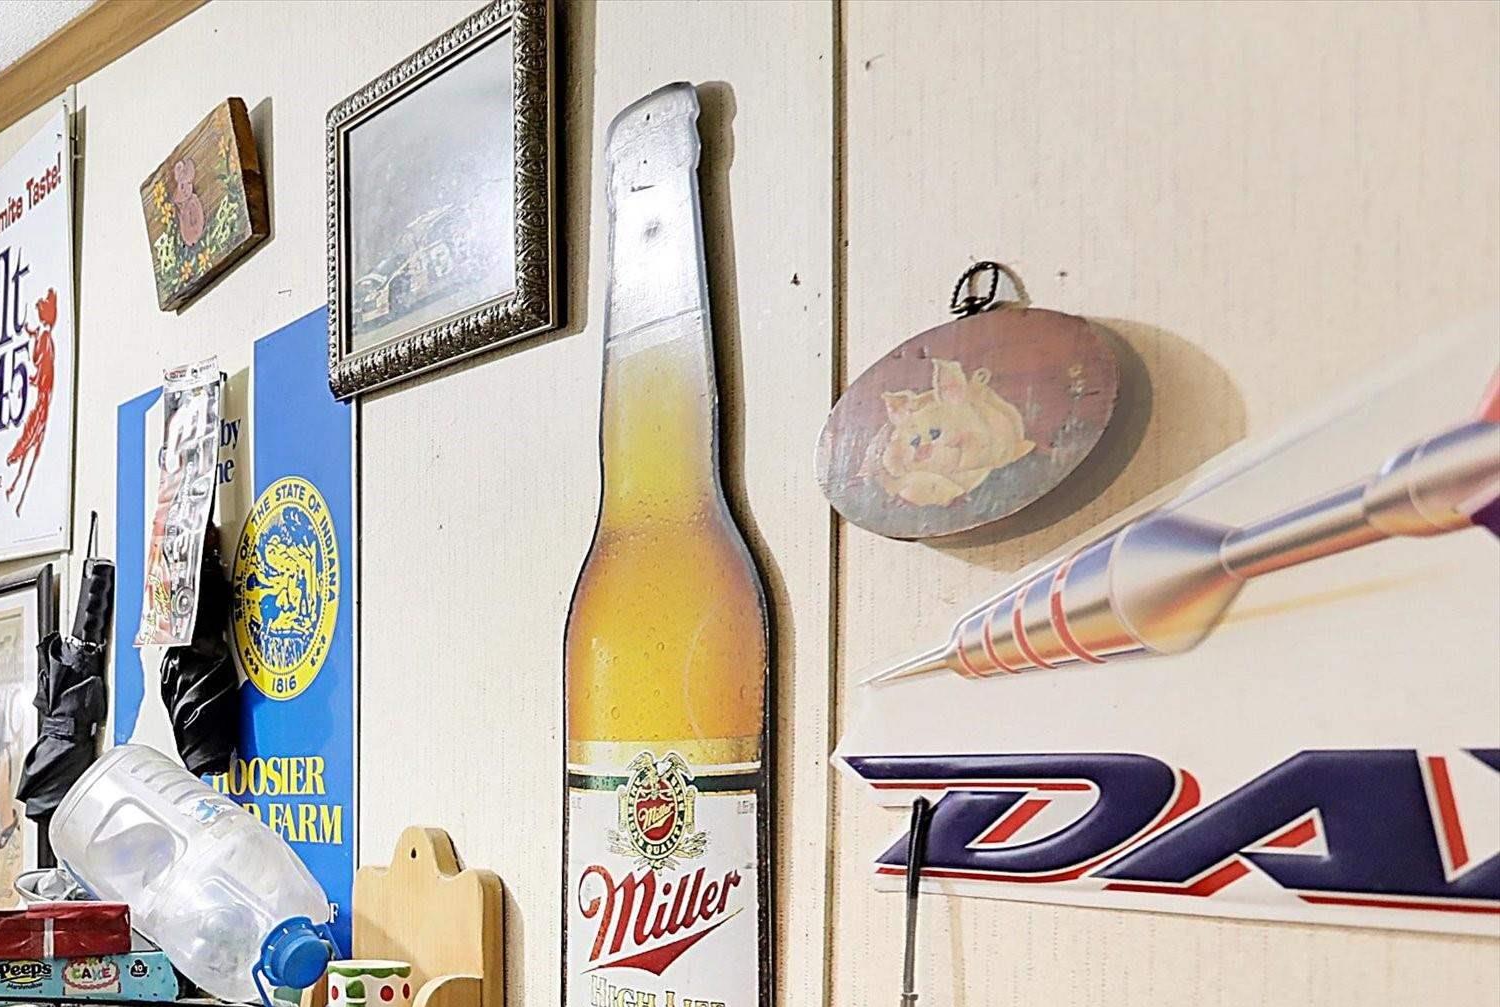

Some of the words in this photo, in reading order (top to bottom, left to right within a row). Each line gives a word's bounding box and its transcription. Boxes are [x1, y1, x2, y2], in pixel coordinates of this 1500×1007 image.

[25, 152, 62, 211] Taste!
[240, 533, 252, 560] OF
[251, 499, 271, 526] THE
[274, 483, 306, 502] STATE
[307, 493, 322, 513] OF
[319, 515, 338, 602] INDIANA
[271, 674, 298, 693] 1816
[268, 803, 343, 845] FARM
[638, 803, 675, 831] Miller
[646, 815, 684, 855] QUALITY
[841, 748, 1500, 908] DA
[578, 865, 742, 963] Miller
[71, 967, 112, 981] CAKE
[134, 964, 144, 973] 10
